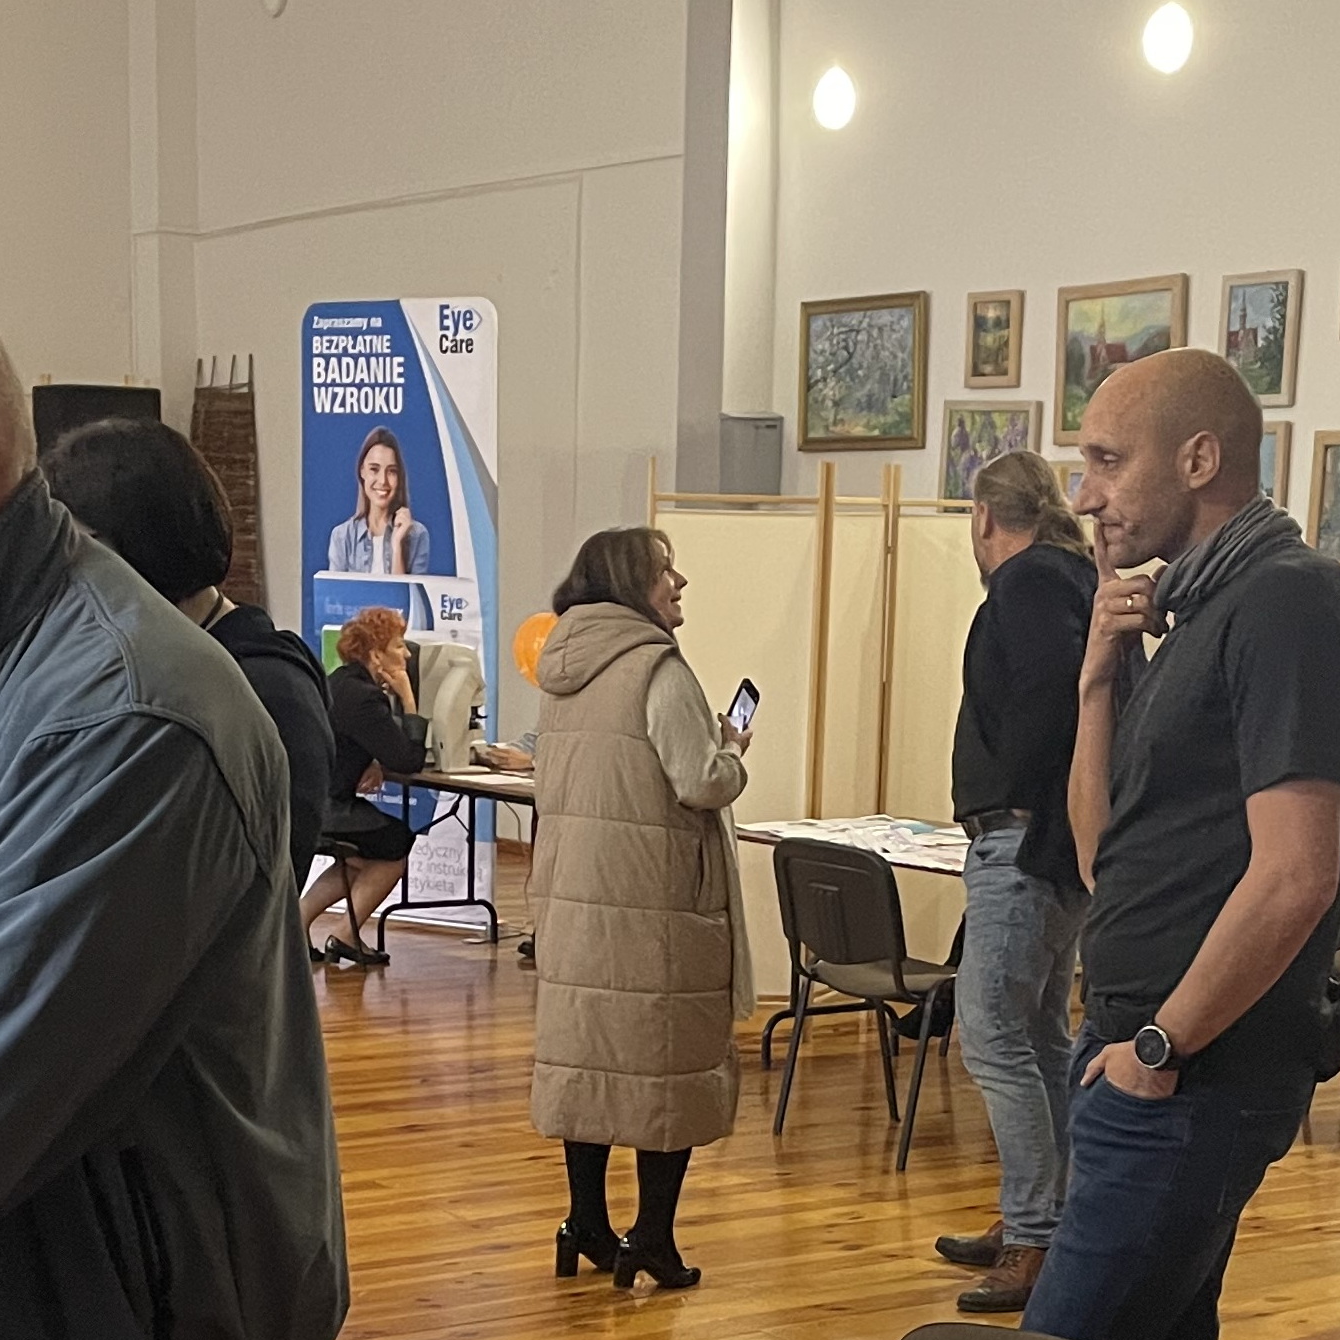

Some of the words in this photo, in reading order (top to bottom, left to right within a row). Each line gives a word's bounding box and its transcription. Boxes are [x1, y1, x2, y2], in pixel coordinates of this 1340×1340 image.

[439, 304, 474, 336] Eye
[313, 334, 391, 354] BEZPŁATNE
[439, 334, 474, 354] Care
[313, 356, 405, 384] BADANIE
[313, 386, 403, 414] WZROKU
[441, 594, 463, 610] Eye
[440, 609, 463, 621] Care
